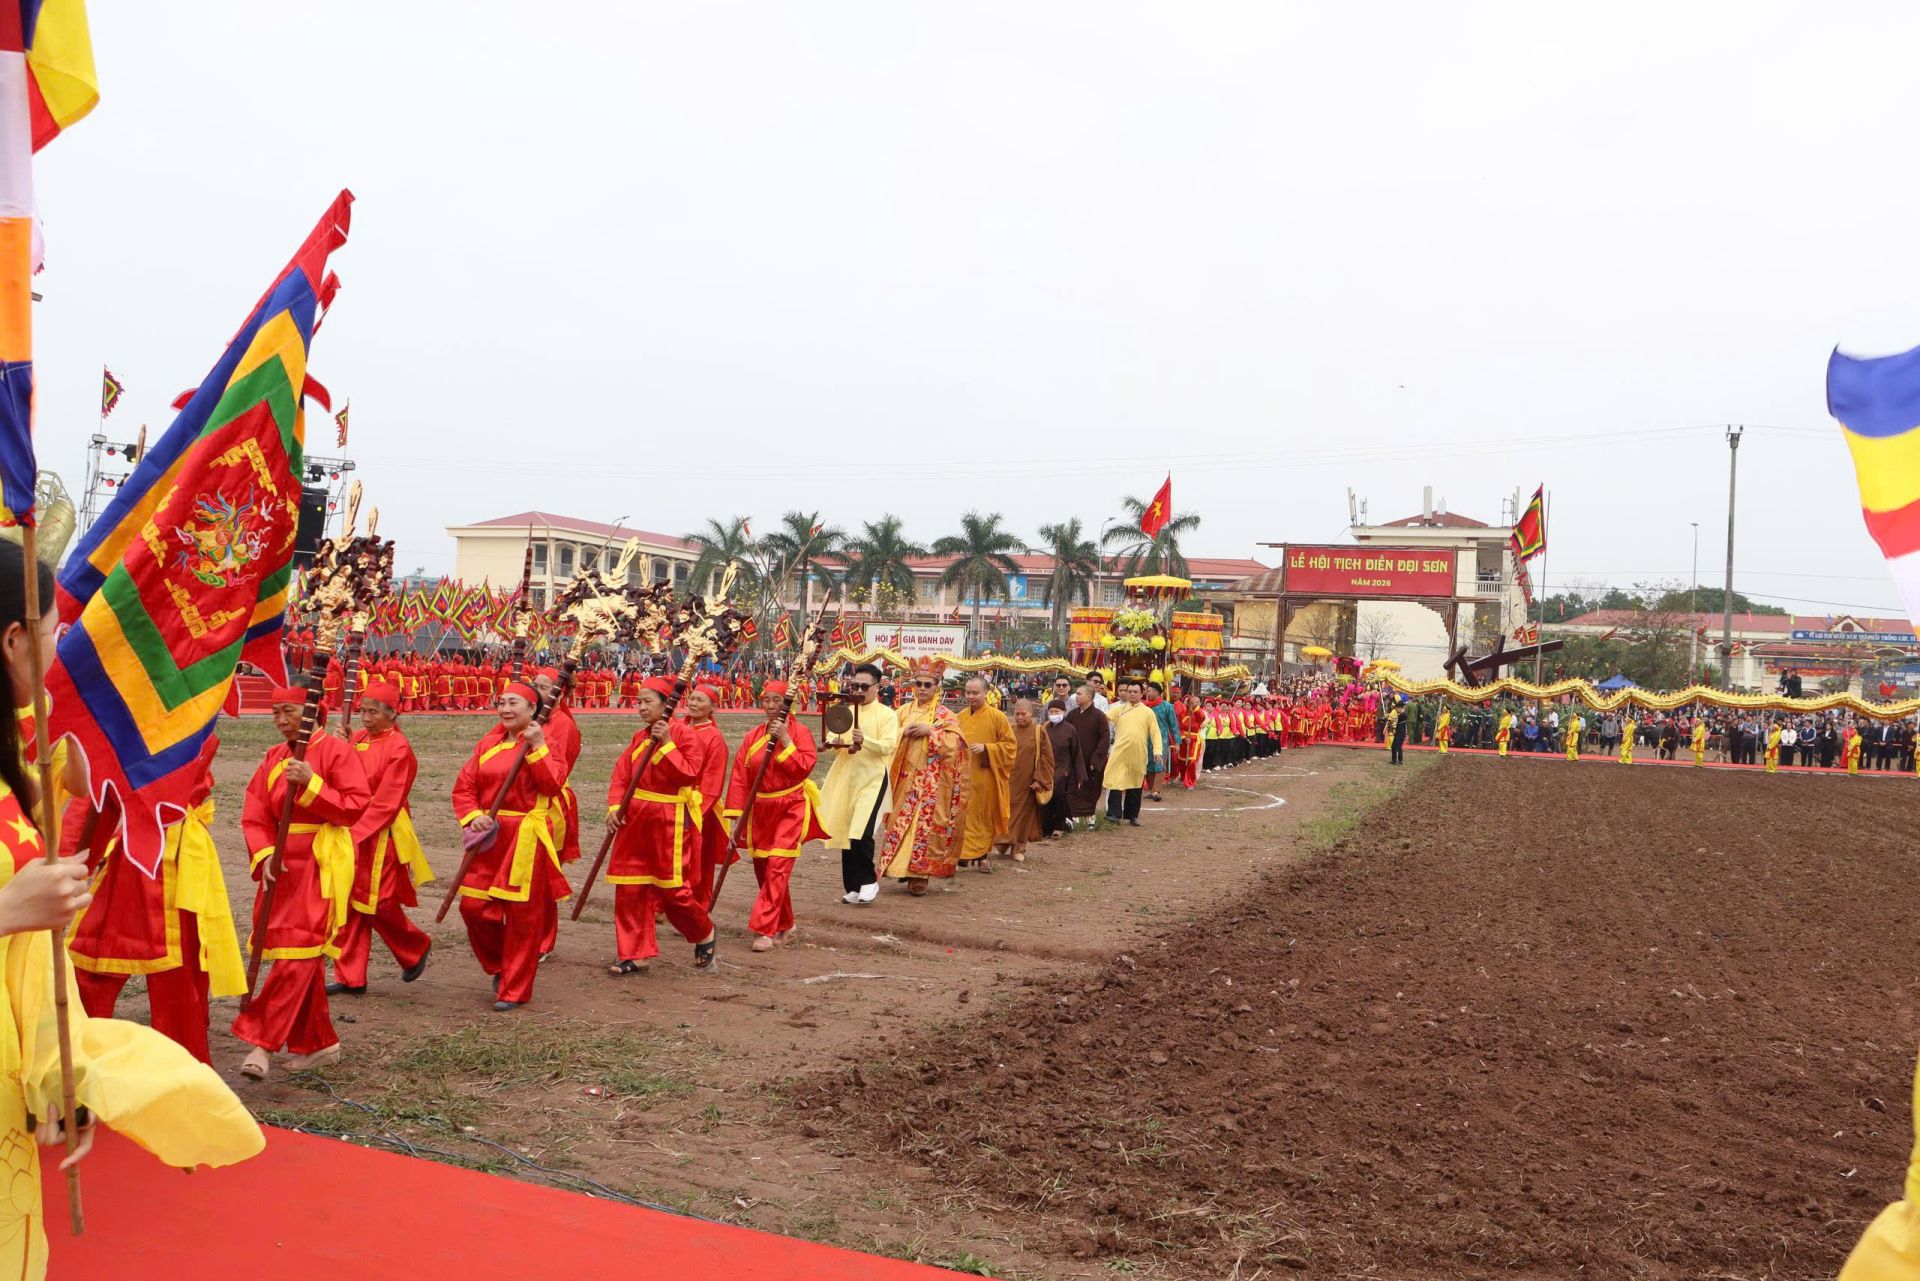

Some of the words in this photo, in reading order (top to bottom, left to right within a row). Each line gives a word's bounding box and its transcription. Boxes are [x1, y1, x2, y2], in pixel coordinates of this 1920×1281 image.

[1291, 552, 1305, 568] LỄ
[1309, 554, 1330, 571] HỘI
[1334, 558, 1362, 572] TỊCH
[1365, 554, 1393, 571] ĐIỀN
[1397, 559, 1419, 574] ĐỌI
[1422, 559, 1448, 573] SƠN
[1351, 577, 1371, 586] NĂM
[1372, 579, 1391, 587] 2026
